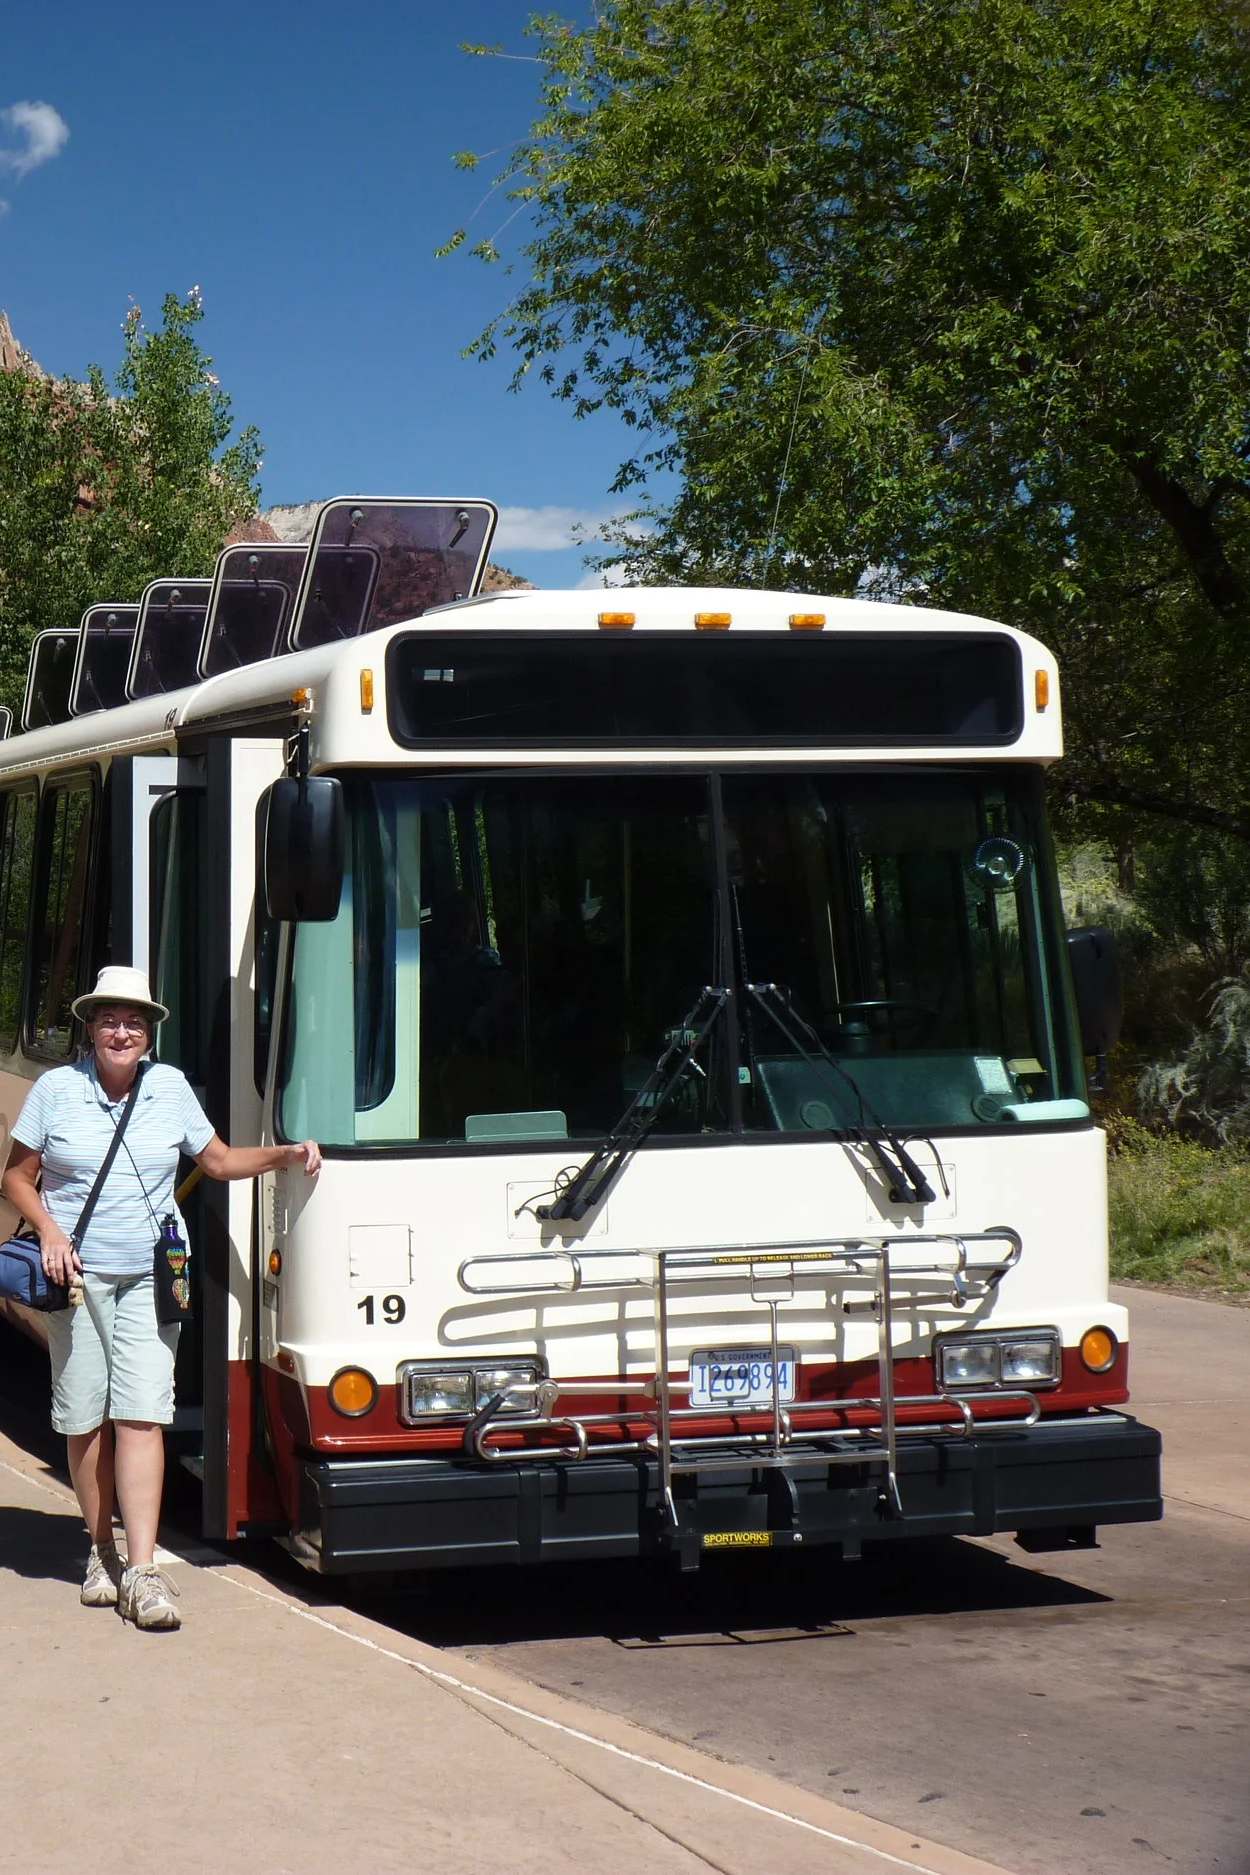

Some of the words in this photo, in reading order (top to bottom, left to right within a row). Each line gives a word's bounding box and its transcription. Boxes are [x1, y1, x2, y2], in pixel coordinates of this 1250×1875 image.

[357, 1294, 406, 1325] 19
[728, 1352, 771, 1361] GOVERNMENT
[703, 1532, 769, 1544] SPORTWORKS
